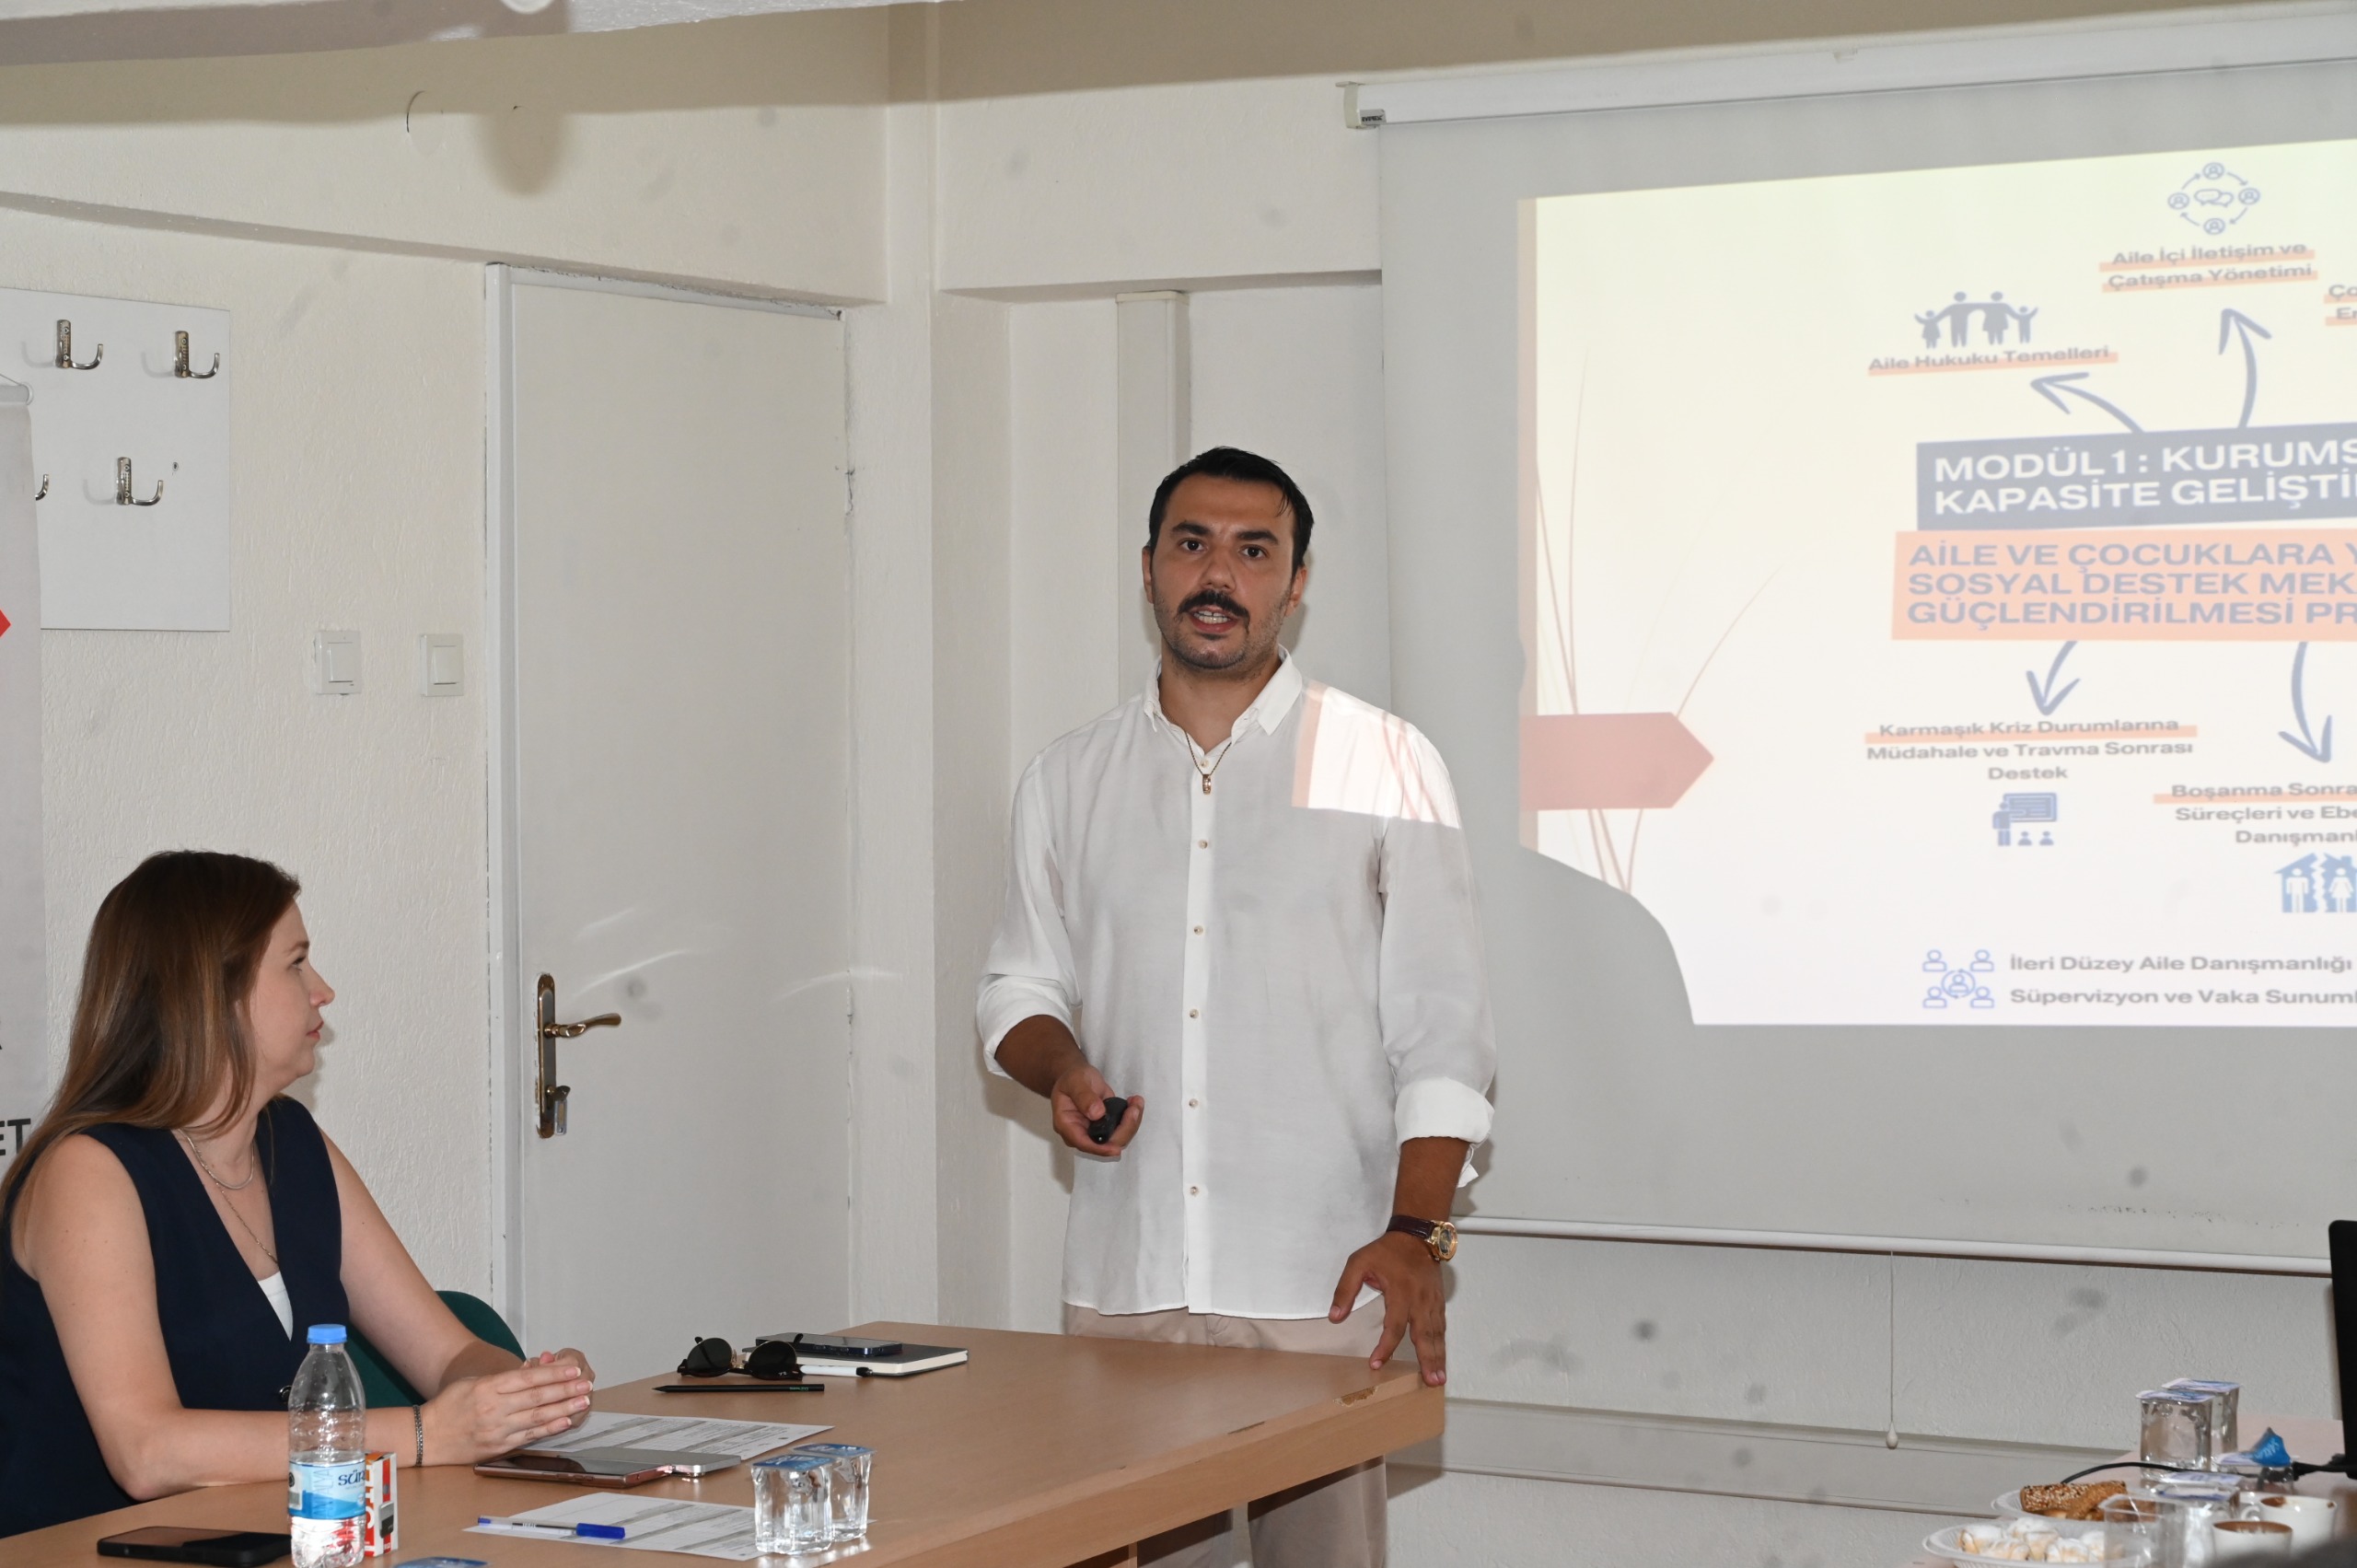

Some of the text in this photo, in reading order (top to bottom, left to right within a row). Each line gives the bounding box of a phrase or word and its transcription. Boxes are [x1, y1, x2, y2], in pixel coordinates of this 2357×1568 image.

[2113, 244, 2306, 264] Aile İçi İletişim ve
[2109, 264, 2312, 290] Çatışma Yönetimi
[1869, 346, 2108, 371] Aile Hukuku Temelleri
[1934, 447, 2106, 482] MODÜL
[1935, 468, 2357, 515] KAPASİTE GELİŞTİ
[1909, 539, 1998, 566] AİLE
[2006, 544, 2060, 566] VE
[2068, 543, 2335, 573] ÇOCUKLARA
[1908, 572, 2357, 596] SOSYAL DESTEK MEK
[1907, 598, 2293, 630] GÜÇLENDİRİLMESİ
[1880, 719, 2178, 738] Karmaşık Kriz Durumlarına
[1867, 740, 2193, 760] Müdahale ve Travma Sonrası
[1988, 766, 2068, 781] Destek
[2172, 784, 2282, 799] Boşanma
[2176, 807, 2281, 823] Süreçleri
[2286, 809, 2314, 819] ve
[2010, 954, 2351, 973] İleri Düzey Aile Danışmanlığı
[2011, 988, 2158, 1005] Süpervizyon
[2165, 993, 2193, 1005] ve
[2199, 990, 2259, 1005] Vaka
